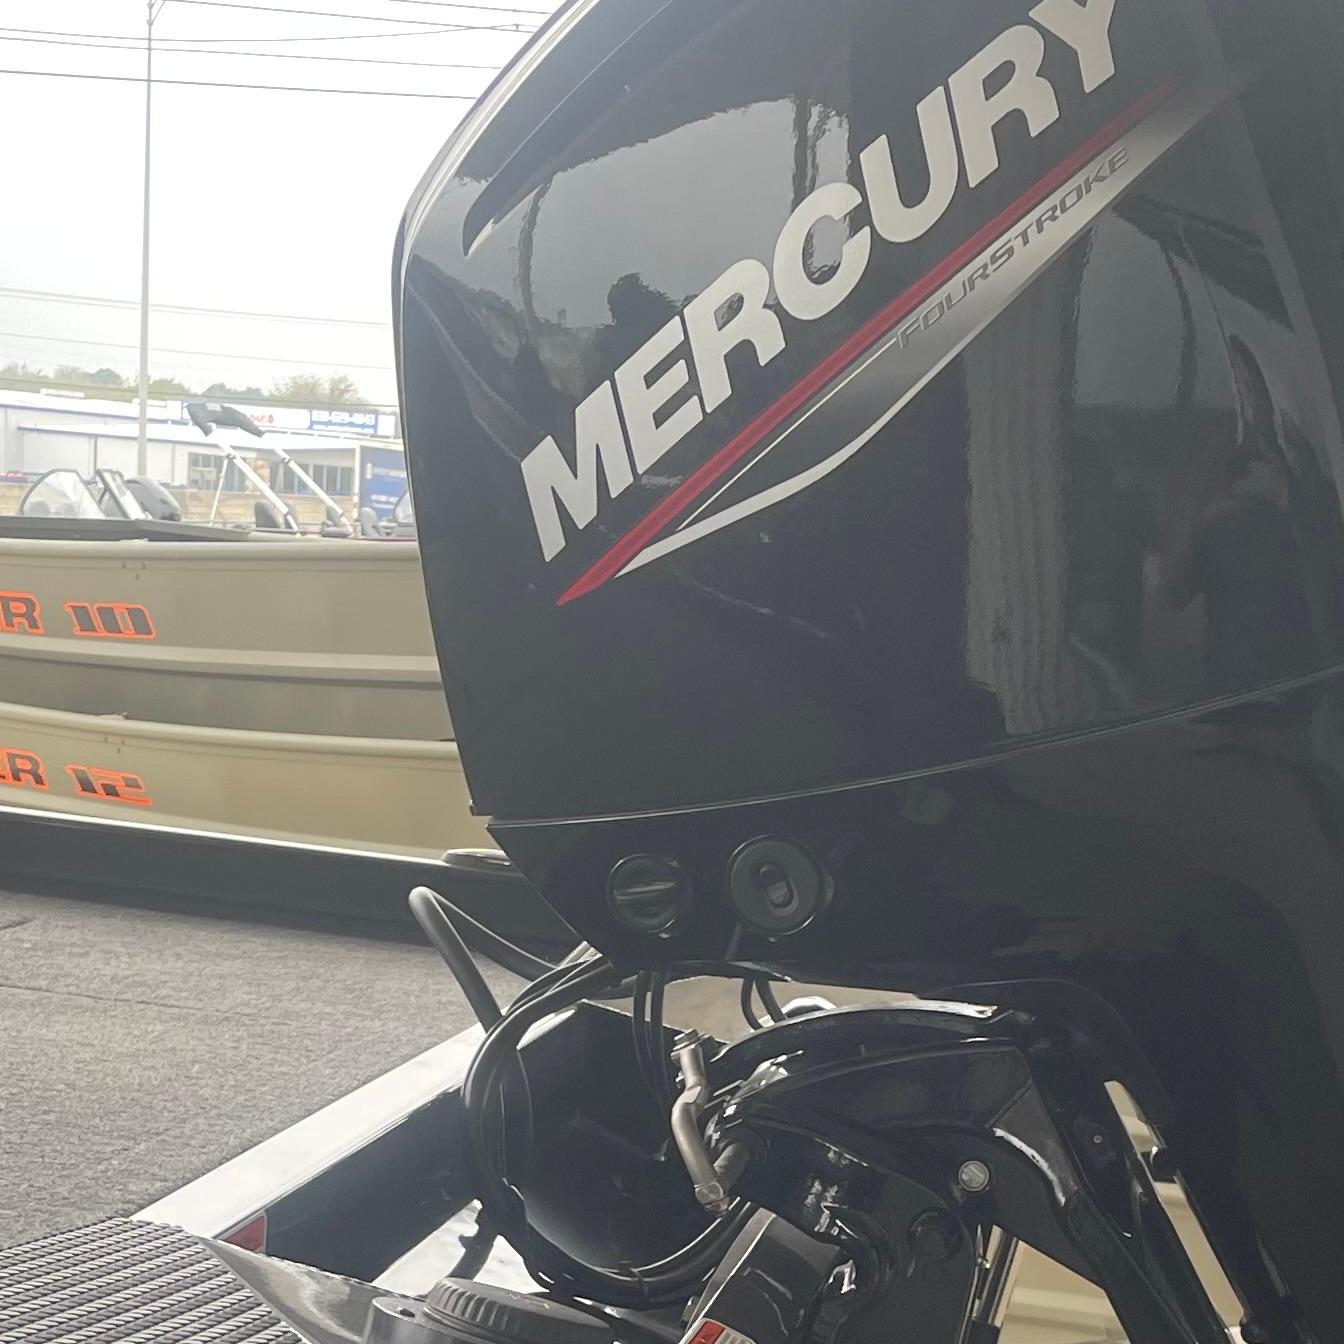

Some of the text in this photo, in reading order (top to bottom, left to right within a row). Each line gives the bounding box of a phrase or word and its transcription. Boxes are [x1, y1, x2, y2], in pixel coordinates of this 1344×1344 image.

[521, 0, 1116, 561] MERCURY
[895, 146, 1129, 351] FOURSTROKE
[65, 764, 152, 806] 12
